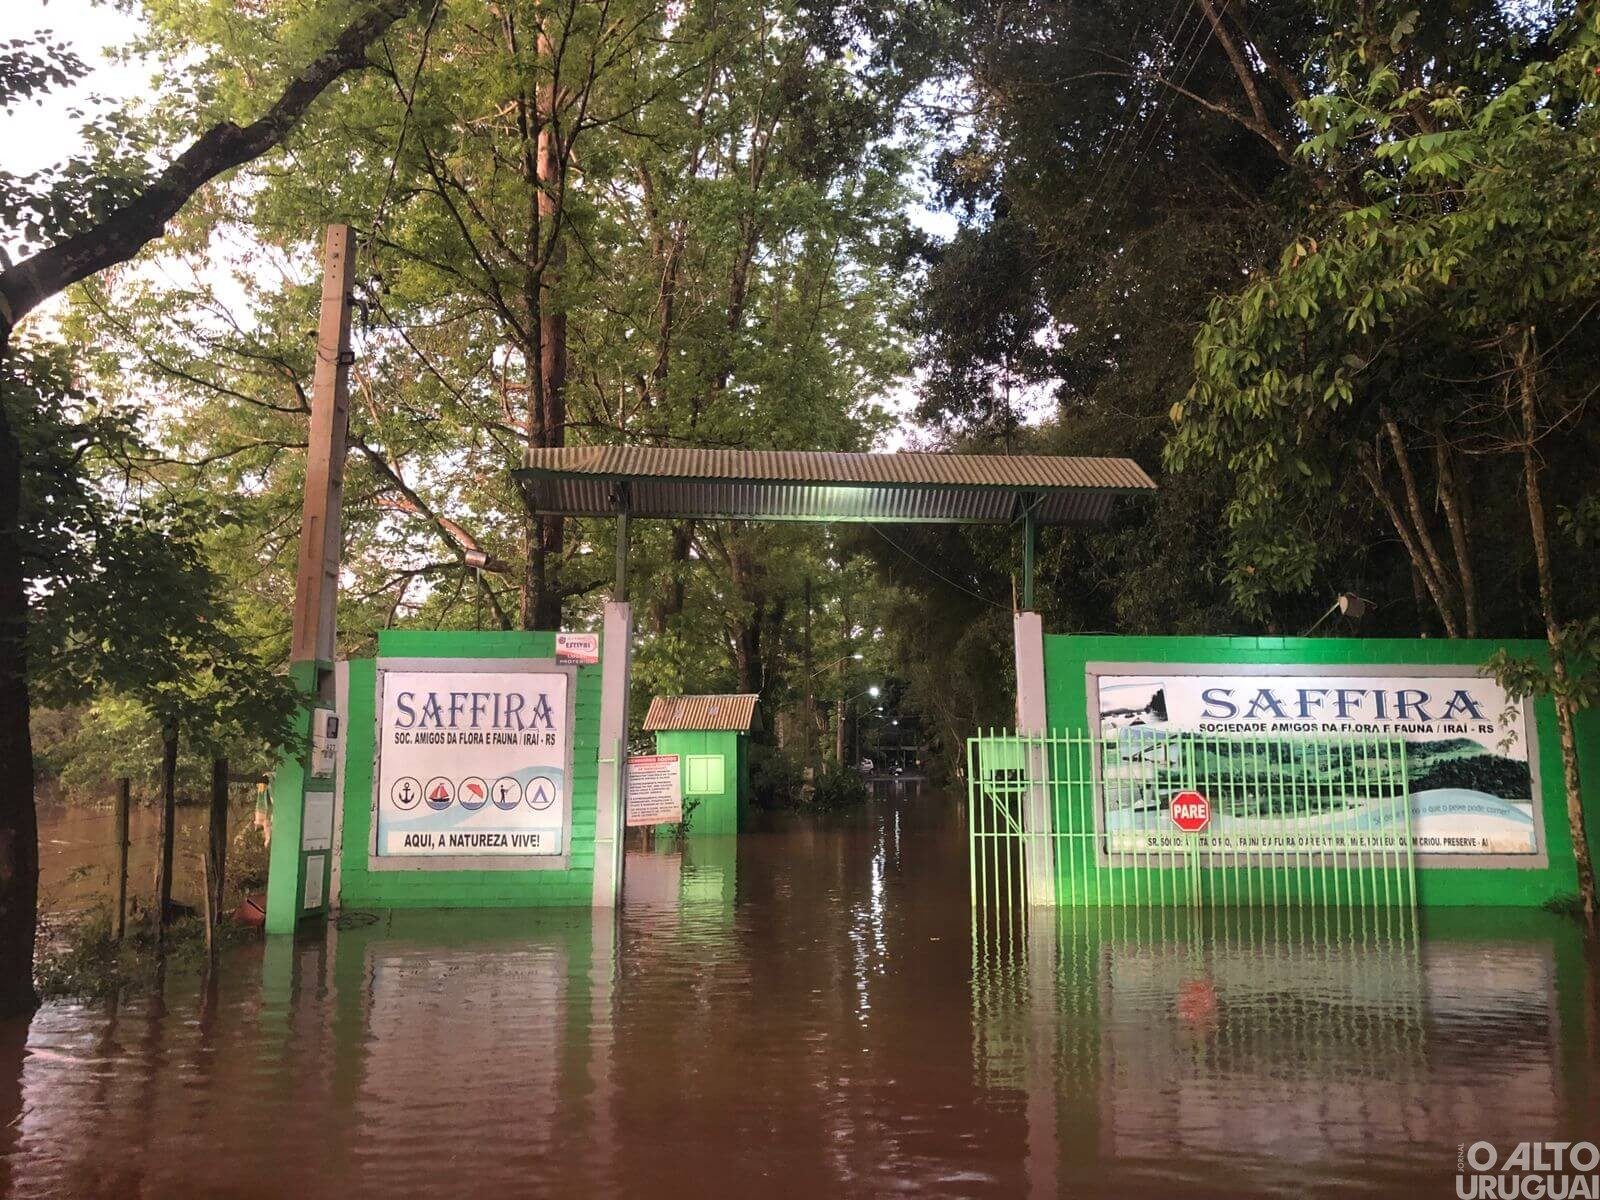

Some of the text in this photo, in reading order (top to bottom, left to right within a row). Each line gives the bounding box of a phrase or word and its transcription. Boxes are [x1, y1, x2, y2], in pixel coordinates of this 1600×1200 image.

[395, 692, 556, 730] SAFFIRA
[1200, 688, 1487, 721] SAFFIRA
[1200, 723, 1267, 732] SOCIEDADE
[1271, 723, 1319, 732] AMIGOS
[1322, 723, 1337, 732] DA
[1395, 724, 1434, 733] FAUNA
[1479, 725, 1494, 733] RS
[395, 733, 412, 744] SOC.
[415, 733, 445, 744] AMIGOS
[447, 733, 457, 744] DA
[460, 733, 484, 744] FLORA
[486, 733, 491, 744] E
[493, 733, 518, 745] FAUNA
[546, 734, 556, 745] RS
[1174, 804, 1206, 819] PARE
[404, 834, 540, 849] AQUI, A NATUREZA VIVE!
[1443, 838, 1476, 847] PRESERVE
